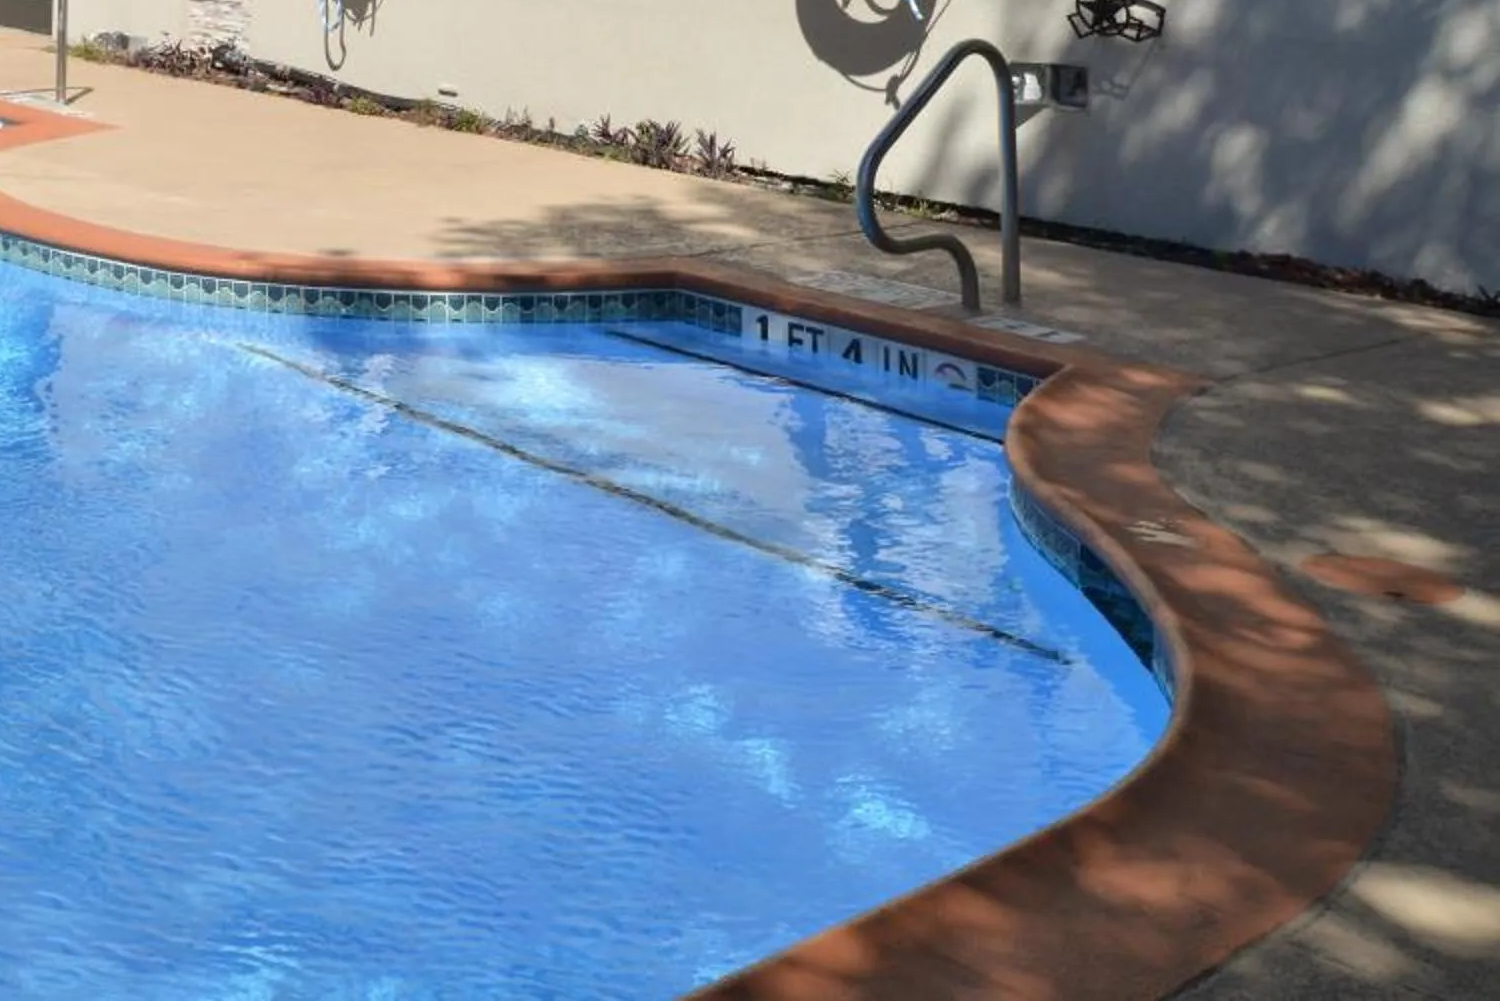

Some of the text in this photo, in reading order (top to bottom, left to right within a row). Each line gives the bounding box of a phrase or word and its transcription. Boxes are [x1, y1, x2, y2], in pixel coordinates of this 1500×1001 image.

[756, 314, 919, 380] 1 FT 4 IN
